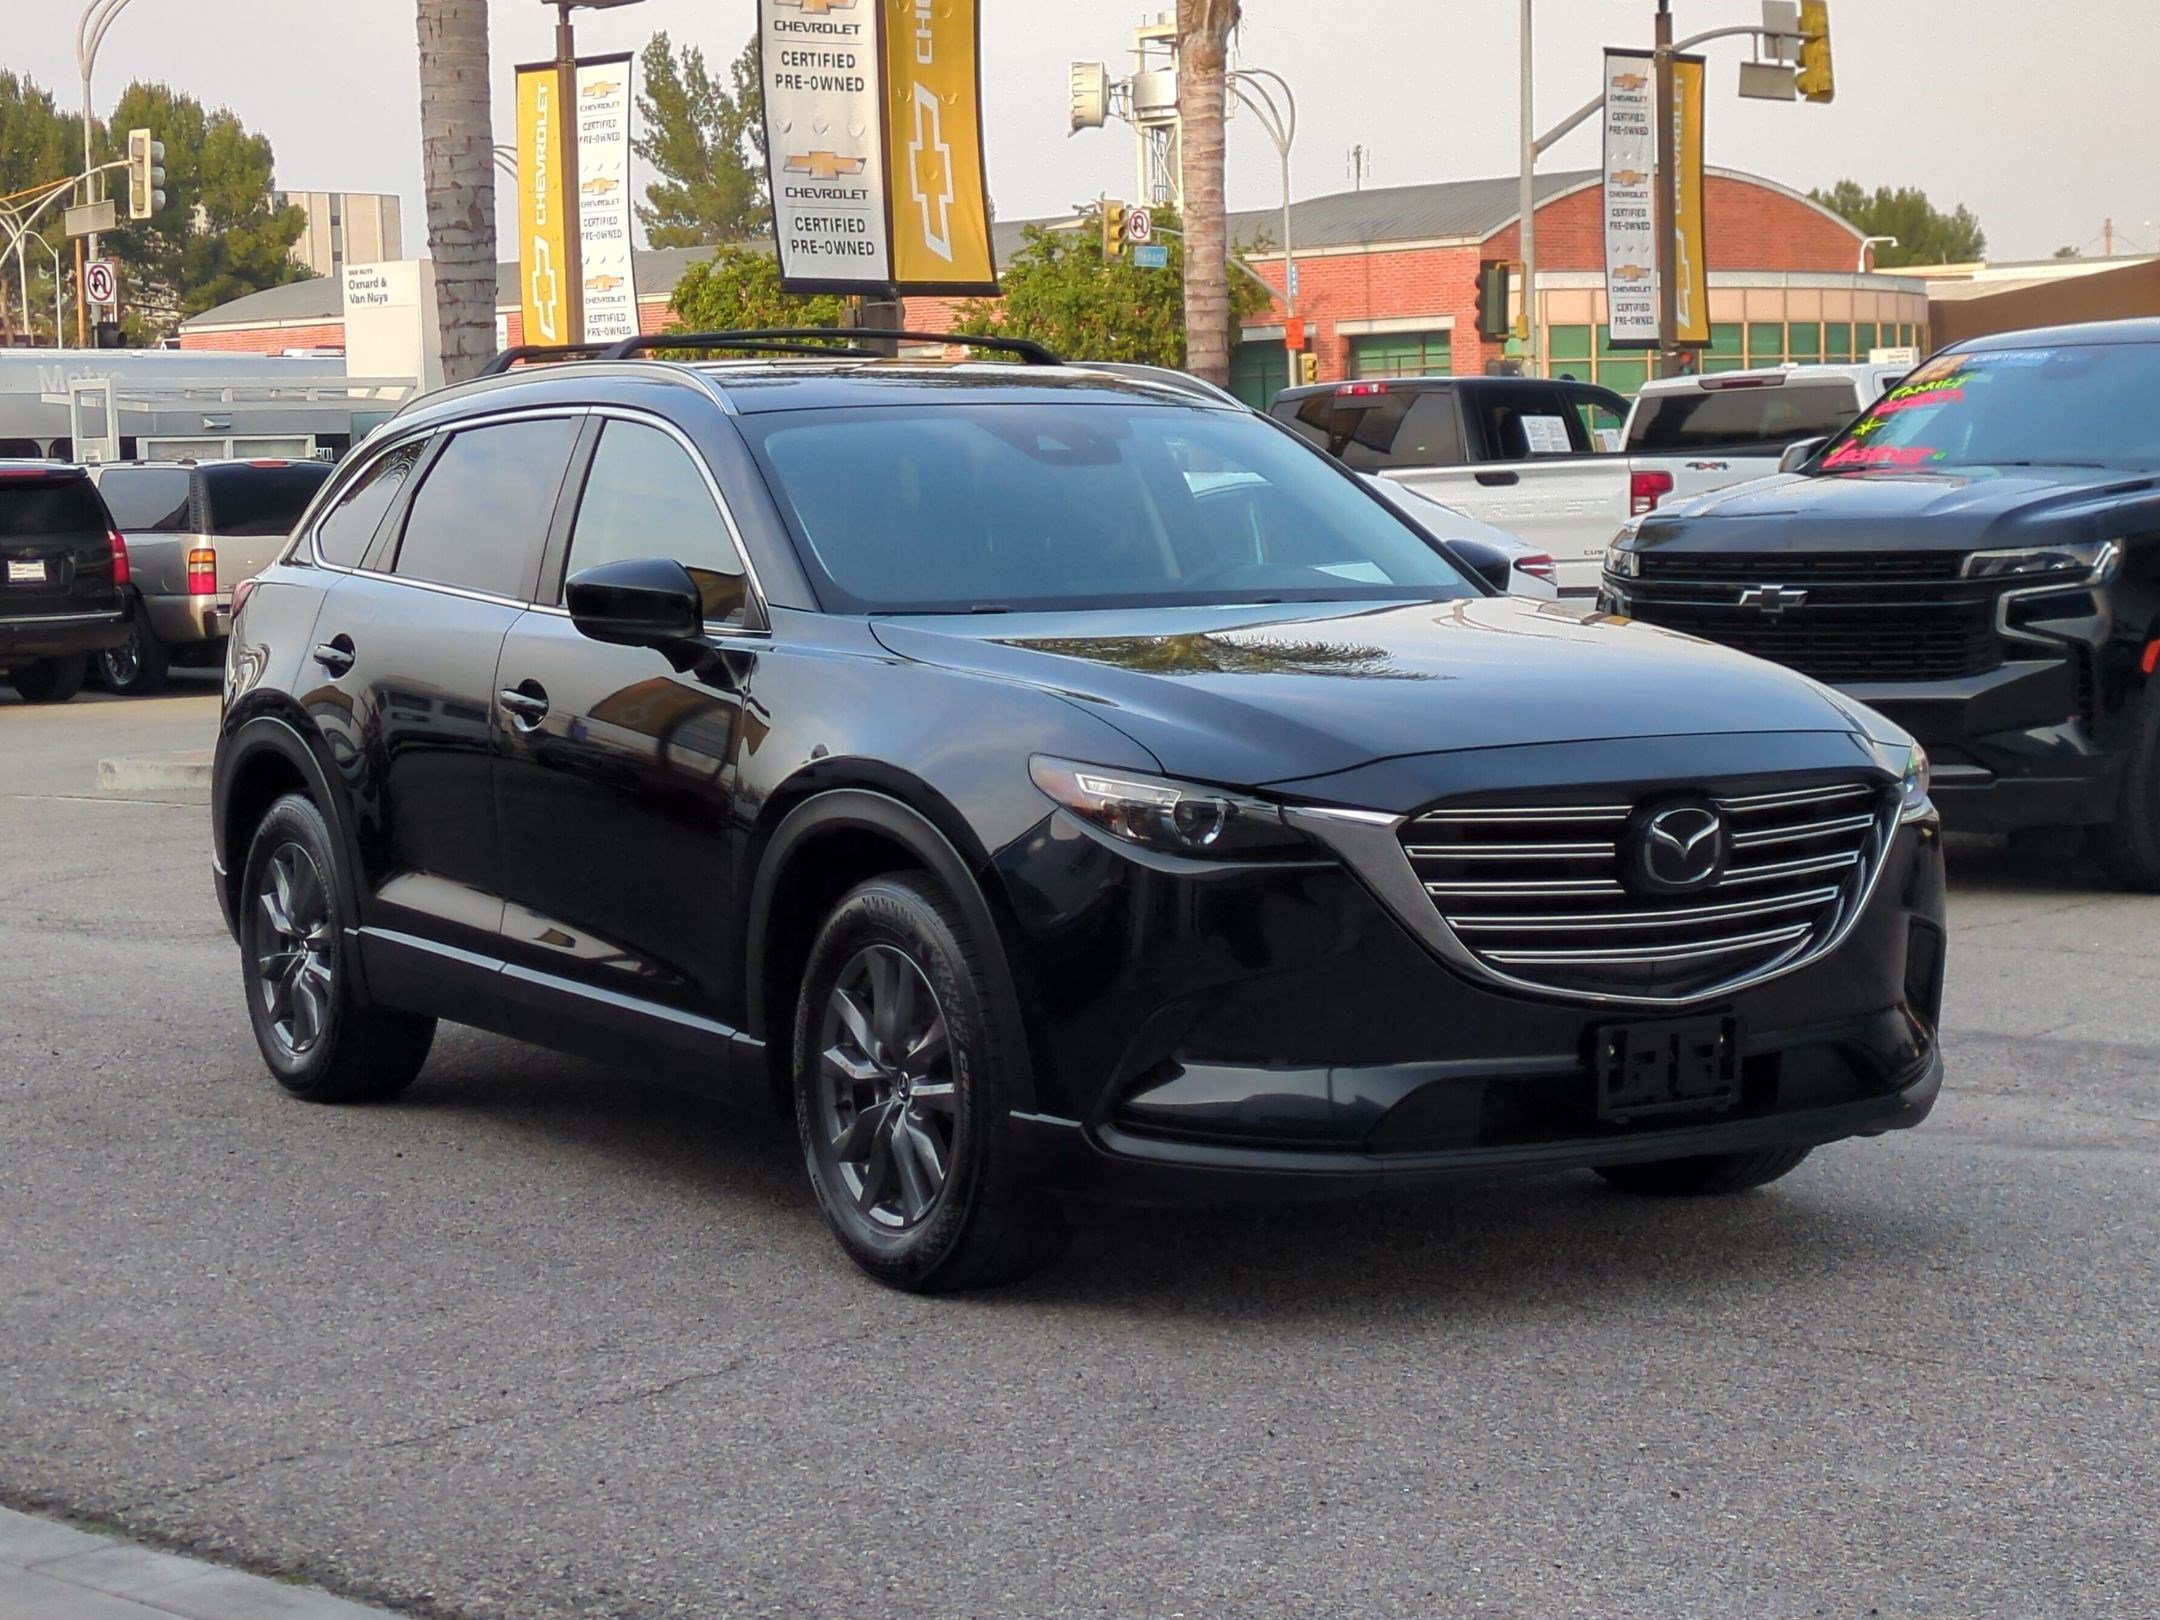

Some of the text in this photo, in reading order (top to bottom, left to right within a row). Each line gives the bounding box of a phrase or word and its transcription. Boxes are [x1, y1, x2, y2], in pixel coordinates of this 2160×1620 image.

[773, 20, 862, 35] CHEVROLET
[781, 51, 856, 69] CERTIFIED
[775, 74, 865, 92] PRE-OWNED
[1610, 94, 1648, 102] CHEVROLET
[580, 100, 620, 112] CHEVROLET
[1612, 112, 1646, 122] CERTIFIED
[582, 119, 617, 131] CERTIFIED
[1609, 125, 1649, 136] PRE-OWNED
[579, 132, 620, 144] PRE-OWNED
[535, 80, 549, 225] CHEVROLET
[785, 187, 869, 200] CHEVROLET
[581, 198, 620, 208] CHEVROLET
[1612, 208, 1647, 218] CERTIFIED
[583, 216, 618, 227] CERTIFIED
[795, 217, 866, 233] CERTIFIED
[1609, 221, 1651, 231] PRE-OWNED
[580, 229, 622, 240] PRE-OWNED
[791, 239, 875, 256] PRE-OWNED
[348, 277, 387, 290] Oxnard &
[349, 292, 388, 305] Van Nuys
[585, 295, 626, 304] CHEVROLET
[1616, 303, 1650, 312] CERTIFIED
[588, 313, 626, 323] CERTIFIED
[1614, 316, 1654, 326] PRE-OWNED
[587, 326, 632, 337] PRE-OWNED
